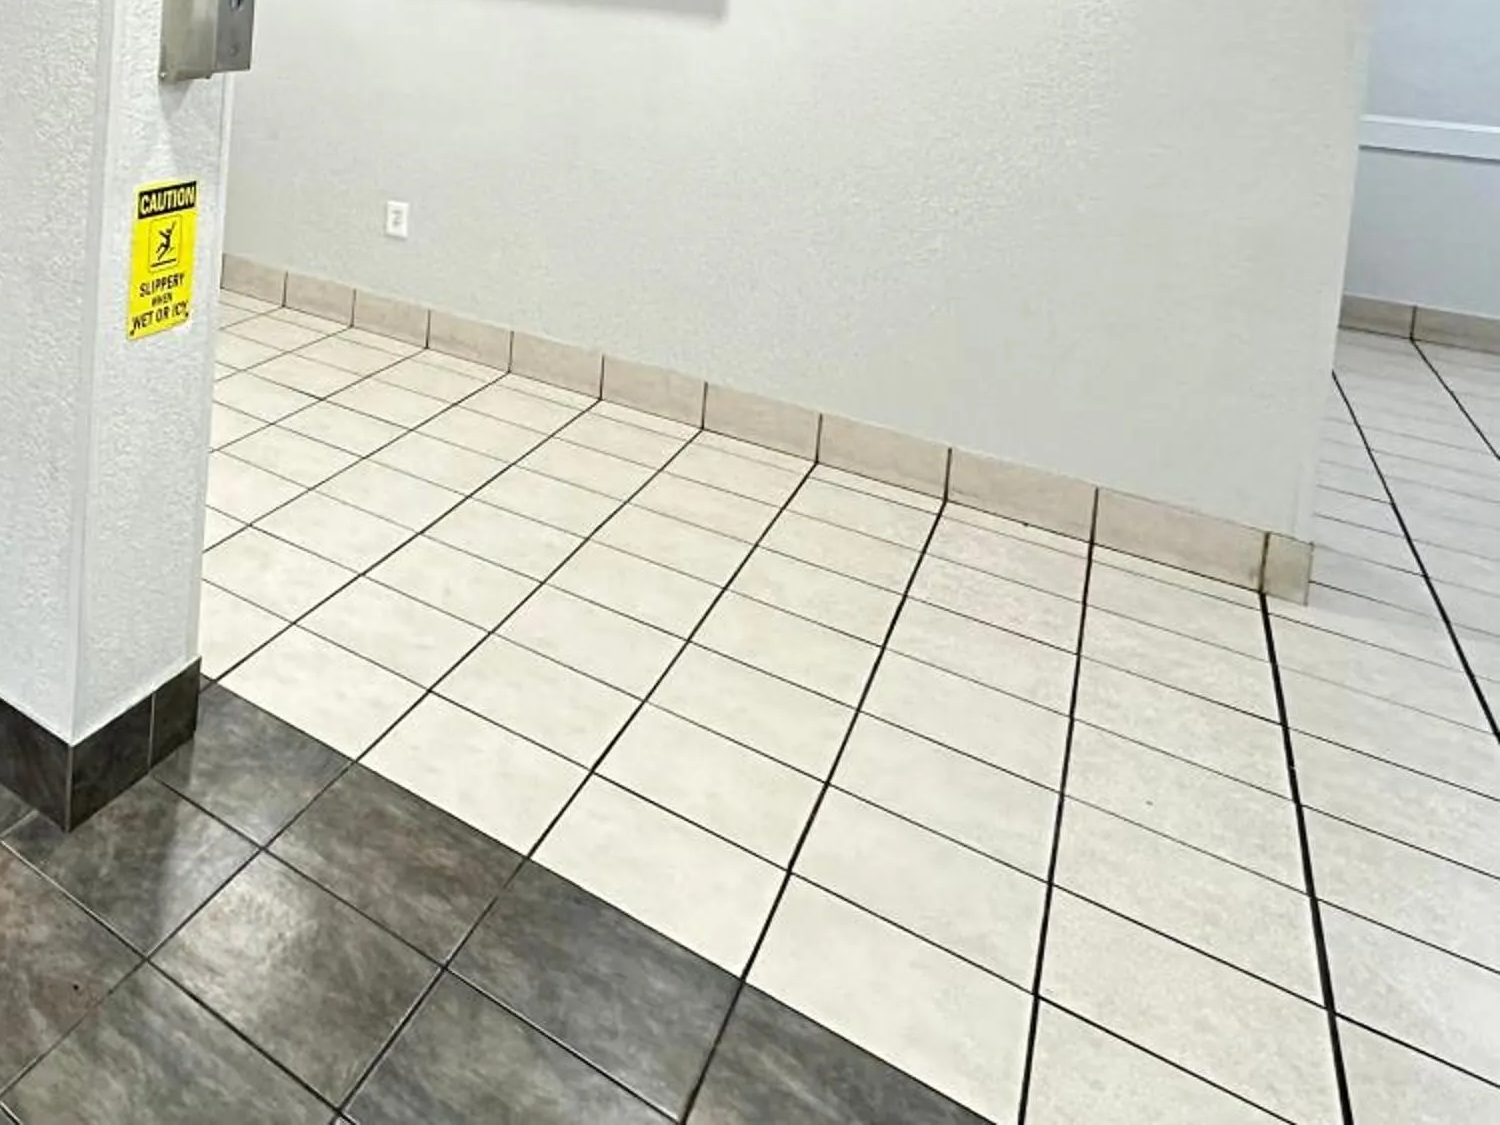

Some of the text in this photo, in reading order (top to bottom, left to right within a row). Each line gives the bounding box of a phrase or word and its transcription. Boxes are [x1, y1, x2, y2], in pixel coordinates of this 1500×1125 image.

[140, 186, 194, 215] CAUTION
[139, 273, 185, 297] SLIPPERY
[151, 292, 173, 307] WHEN
[131, 299, 188, 330] WET OR ICY
